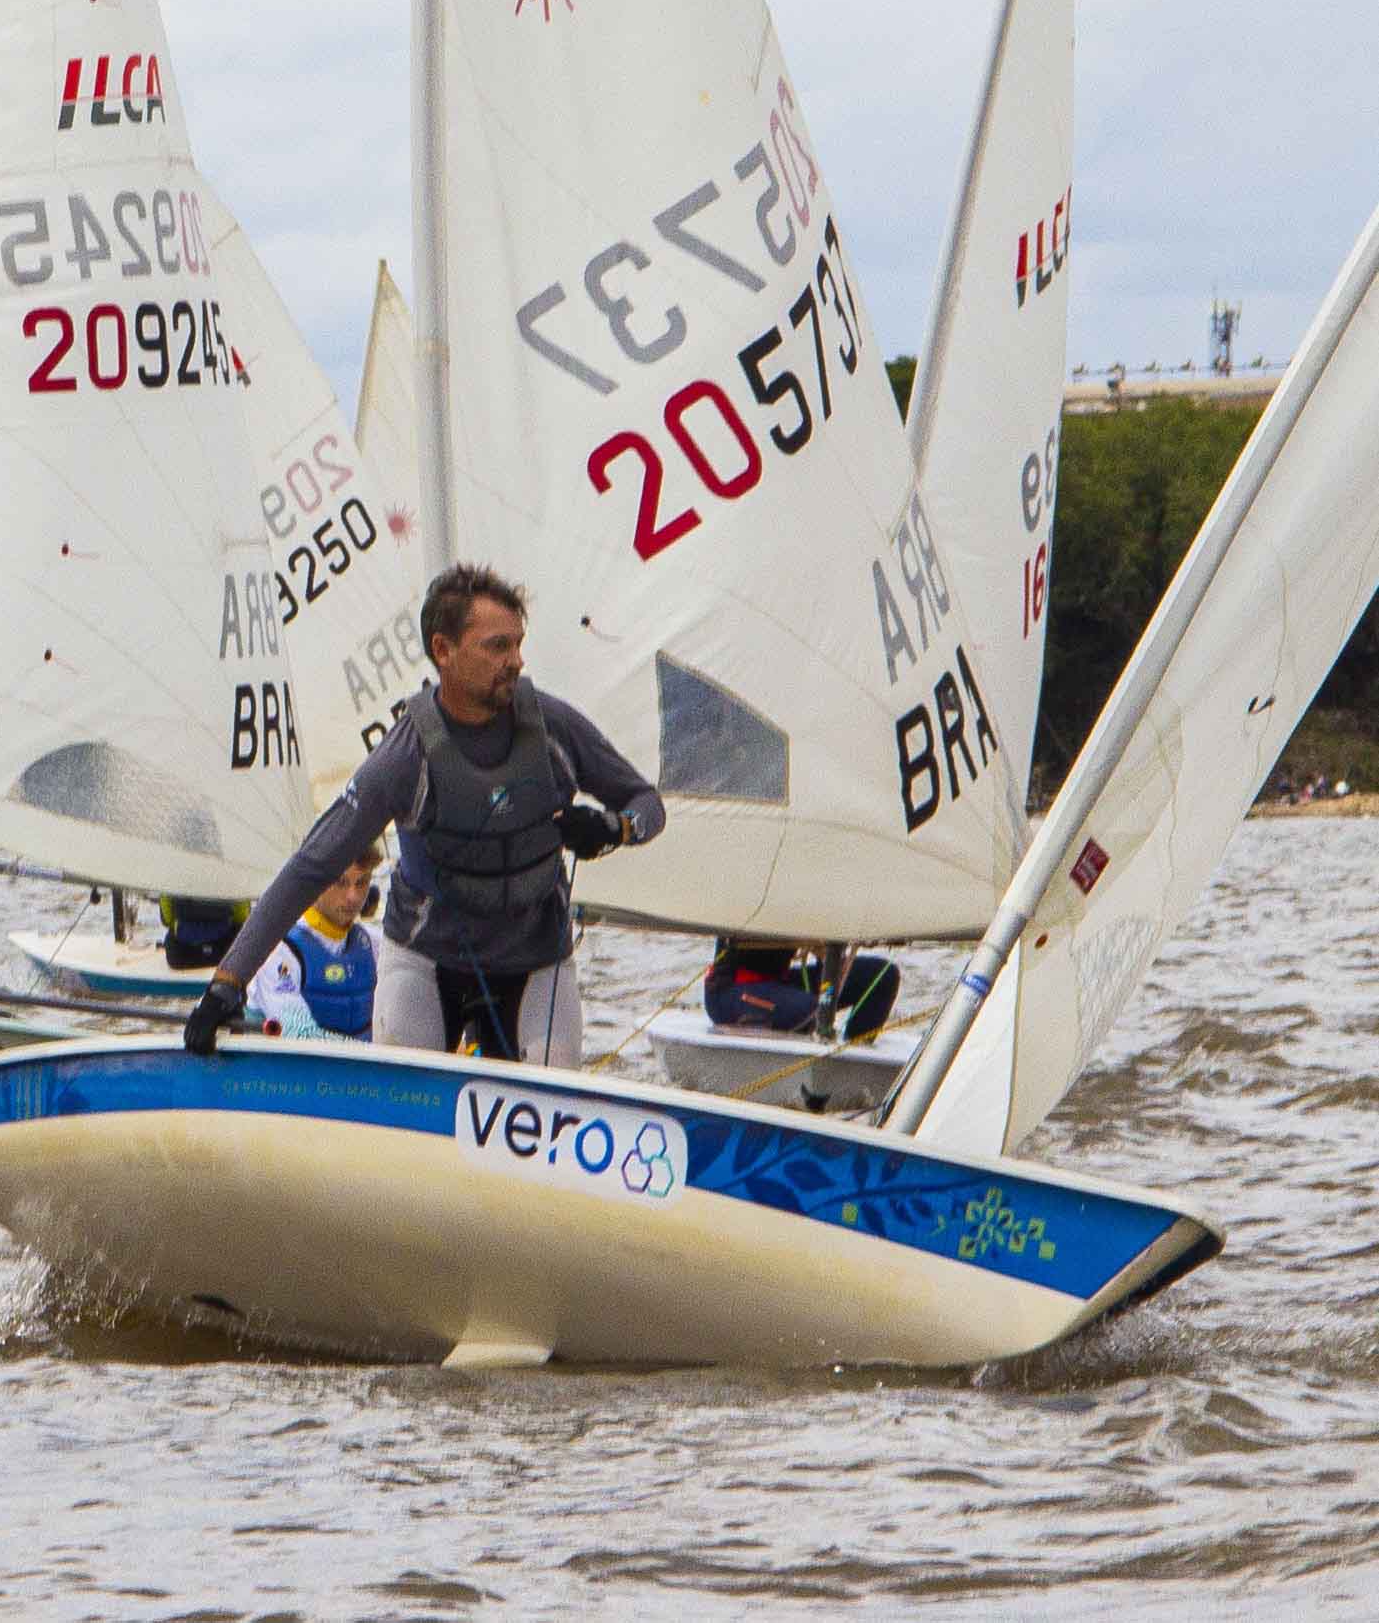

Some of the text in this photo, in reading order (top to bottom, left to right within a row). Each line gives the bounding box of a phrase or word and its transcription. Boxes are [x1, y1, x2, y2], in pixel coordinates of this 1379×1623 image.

[58, 54, 165, 131] ILCA
[22, 299, 231, 394] 209245
[588, 212, 862, 562] 205737
[231, 681, 301, 770] BRA
[896, 644, 998, 833] BRA
[469, 1089, 614, 1175] vero
